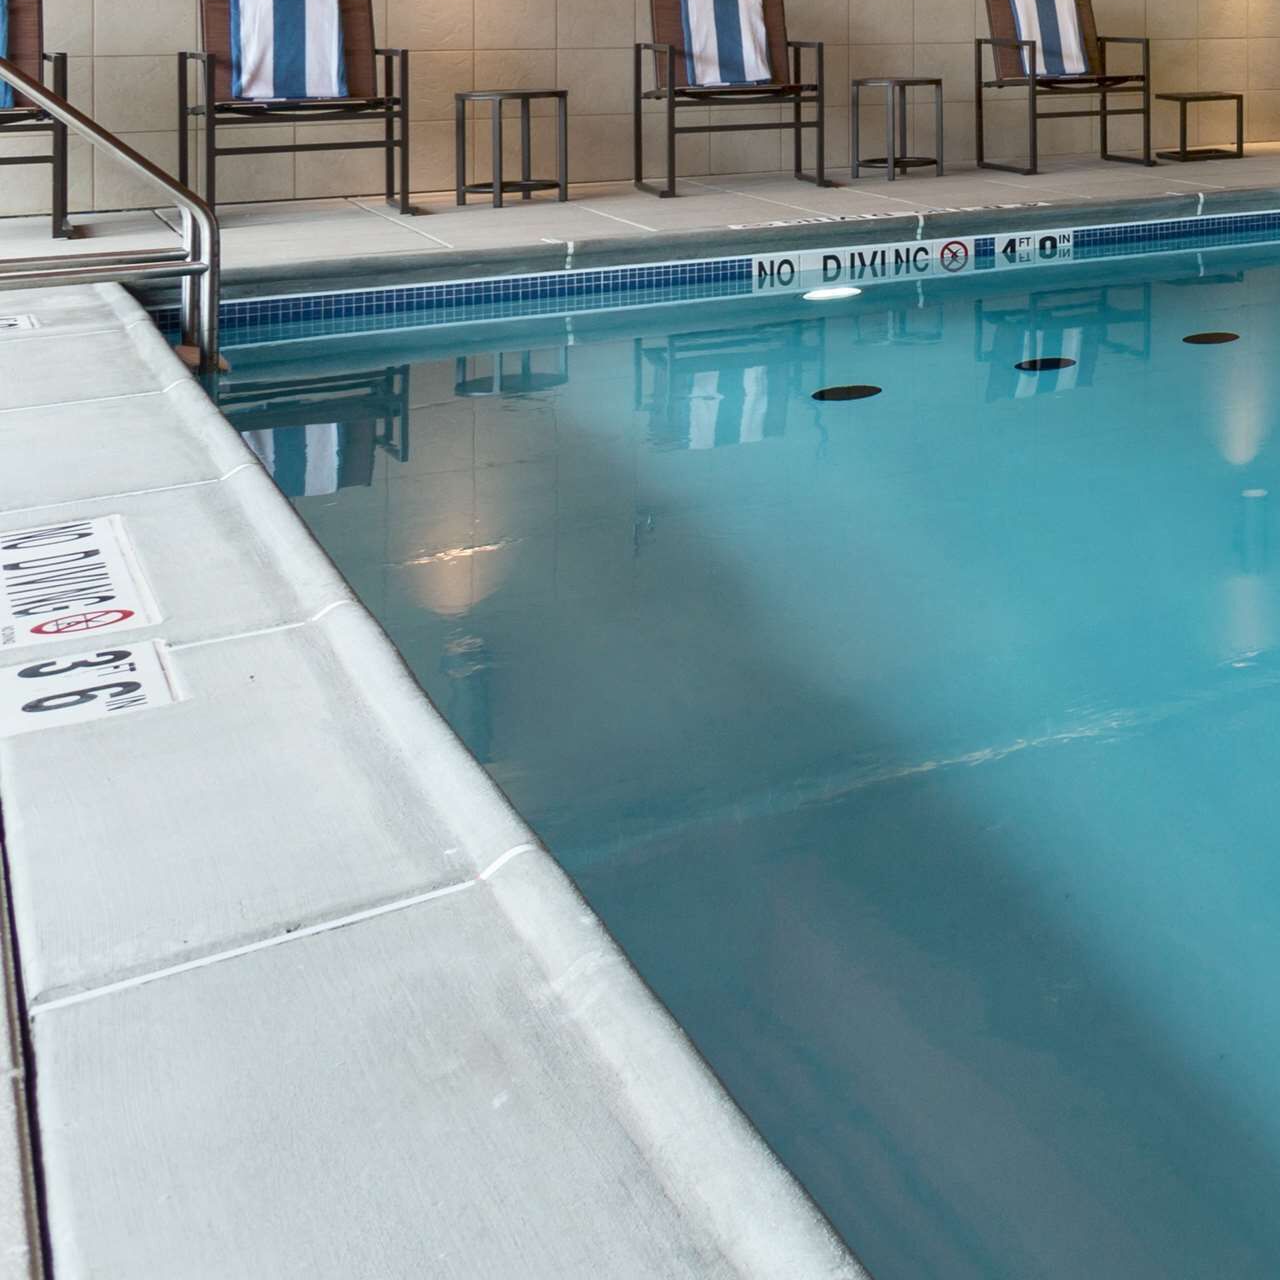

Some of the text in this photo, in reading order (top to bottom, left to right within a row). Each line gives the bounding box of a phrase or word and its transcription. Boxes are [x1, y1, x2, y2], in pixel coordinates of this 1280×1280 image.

[1018, 236, 1032, 248] FT
[1058, 233, 1071, 245] IN
[757, 258, 796, 286] NO
[0, 521, 117, 617] NO DIVING
[17, 650, 133, 679] 3
[21, 681, 142, 713] 6
[105, 694, 148, 712] IN
